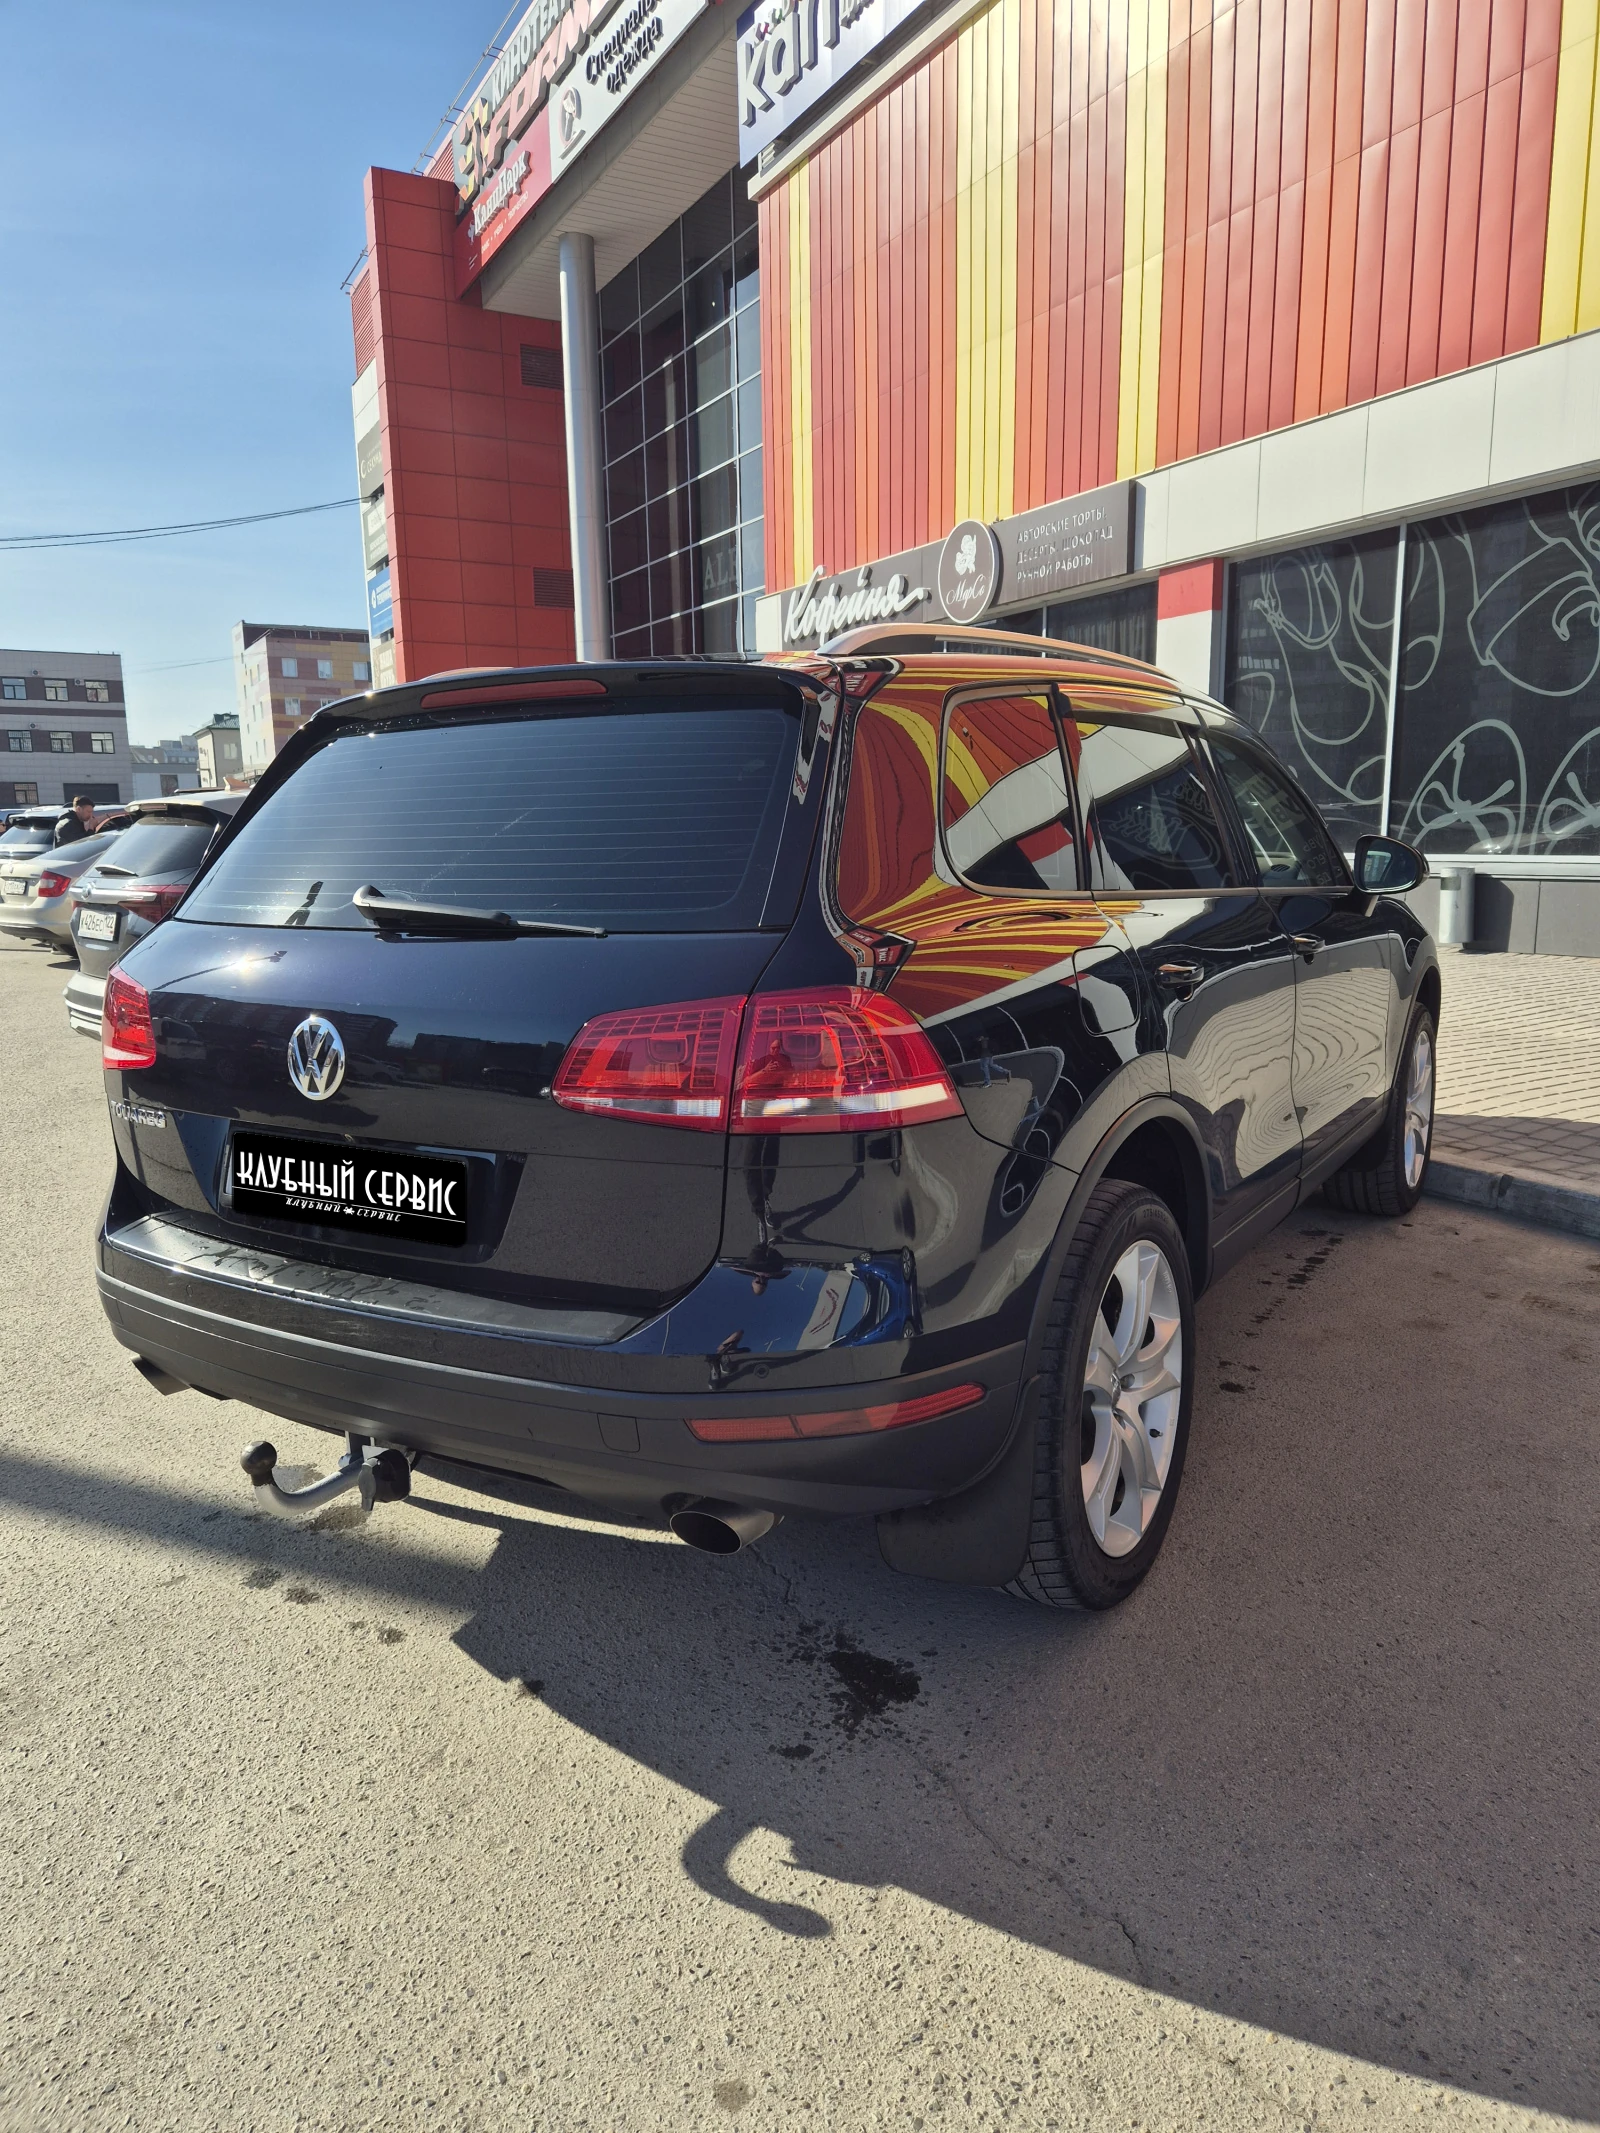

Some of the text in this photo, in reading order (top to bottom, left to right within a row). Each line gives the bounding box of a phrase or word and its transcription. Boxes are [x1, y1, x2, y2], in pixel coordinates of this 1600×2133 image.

[492, 0, 566, 113] КИНОТЕА
[606, 16, 664, 95] одежда
[473, 150, 531, 237] КанцПарк
[1016, 517, 1069, 544] АВТОРСКИЕ
[1062, 525, 1113, 551] ШОКОЛАД
[1017, 552, 1093, 583] РУЧНОЙ РАБОТЫ
[784, 565, 931, 647] Кофейня
[111, 1100, 168, 1129] TOUAREG
